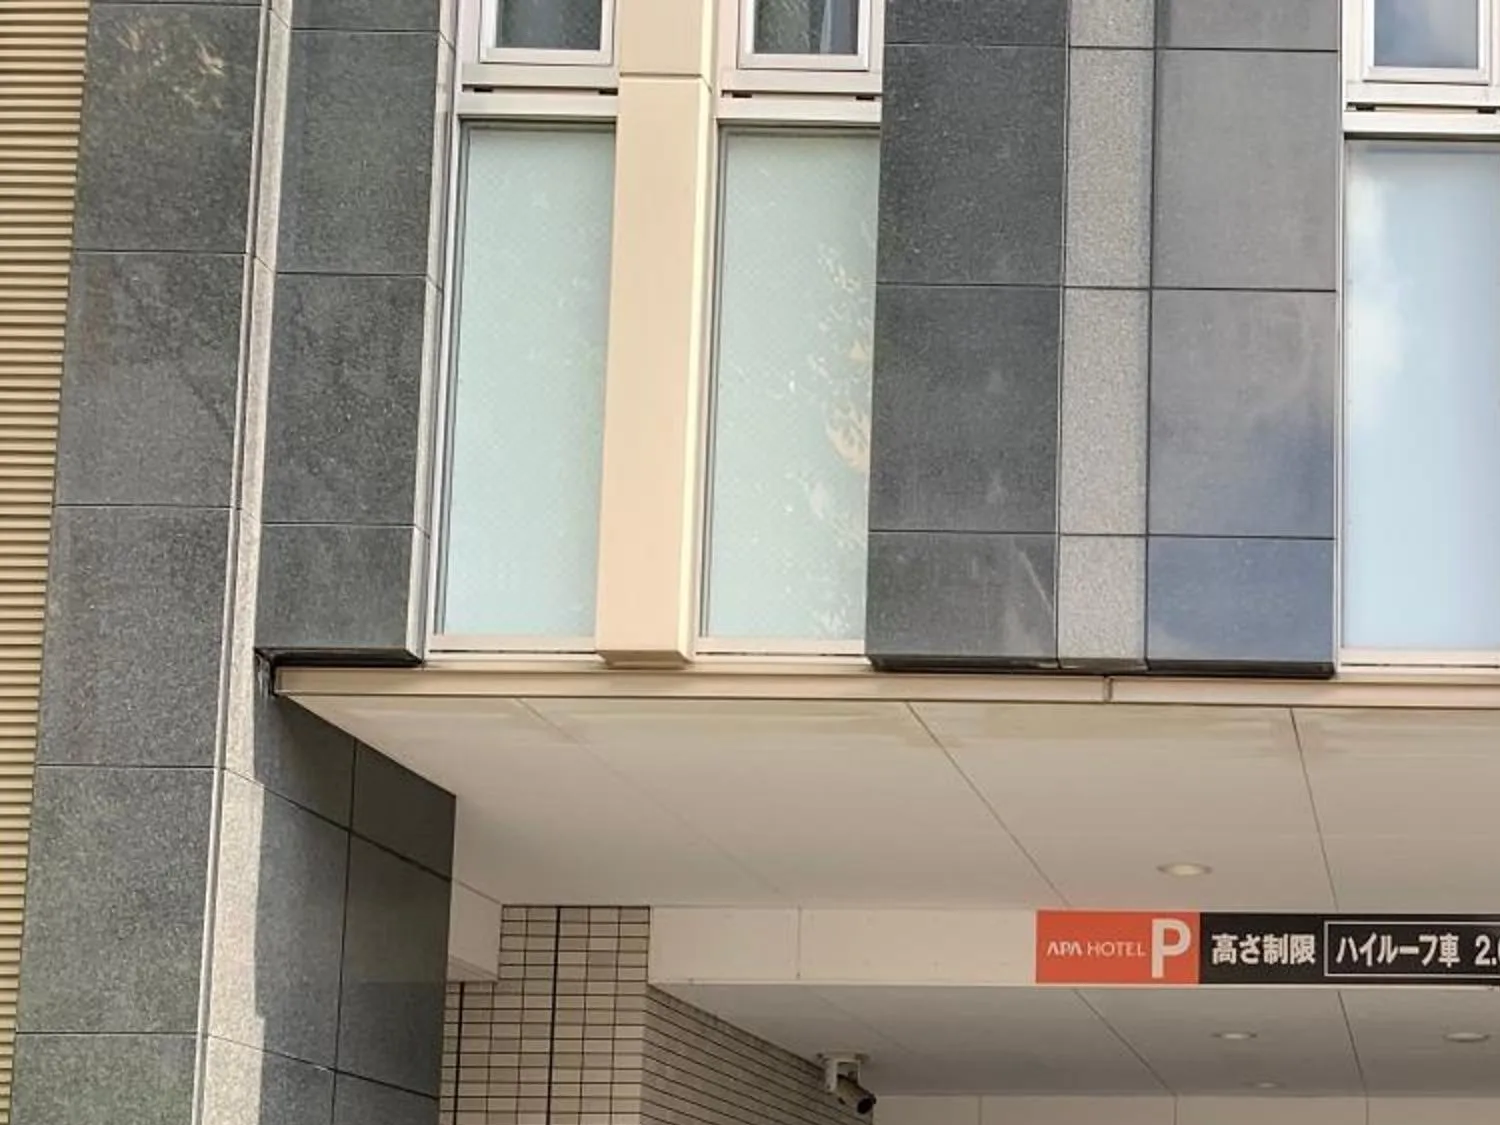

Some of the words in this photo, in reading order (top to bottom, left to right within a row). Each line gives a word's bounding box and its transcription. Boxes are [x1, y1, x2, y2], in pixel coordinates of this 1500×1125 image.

[1046, 941, 1083, 957] APA
[1087, 941, 1147, 957] HOTEL
[1151, 918, 1192, 979] P
[1211, 933, 1316, 965] 高さ制限
[1335, 932, 1461, 968] ハイルーフ車
